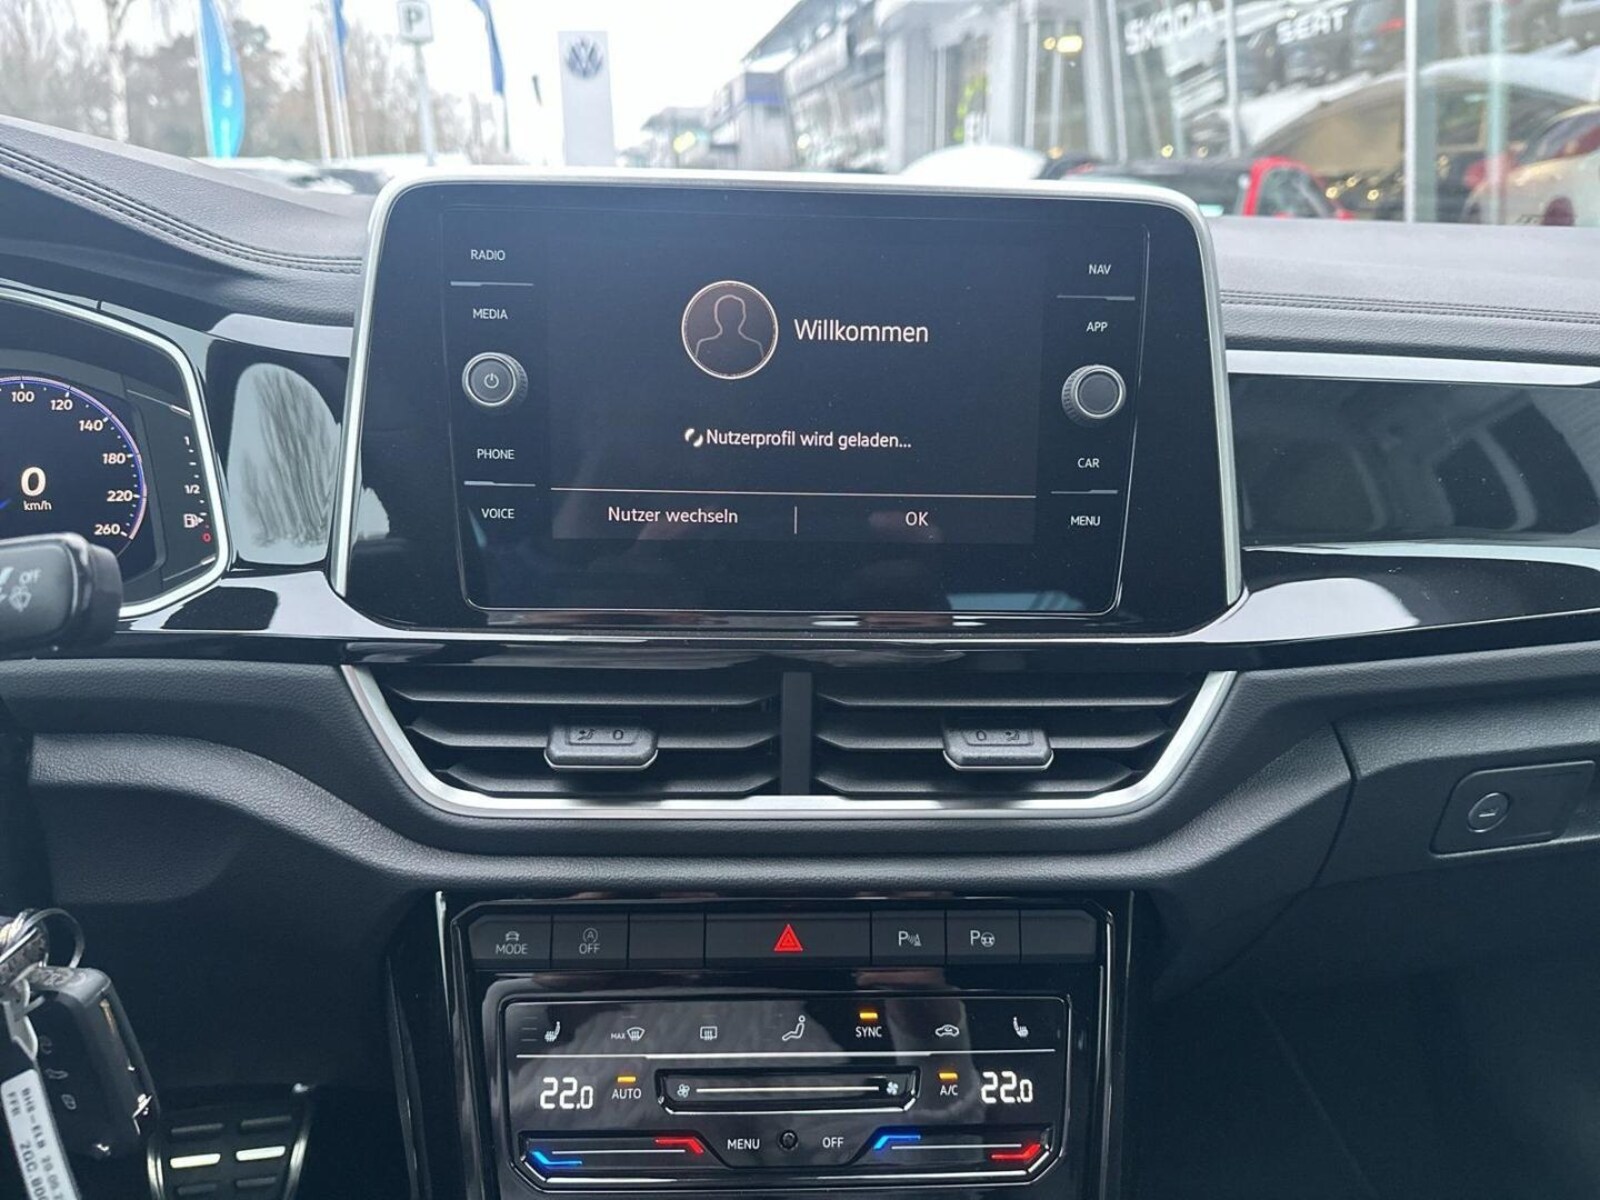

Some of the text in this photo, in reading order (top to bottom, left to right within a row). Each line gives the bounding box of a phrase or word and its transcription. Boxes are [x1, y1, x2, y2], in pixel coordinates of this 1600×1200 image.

[405, 5, 423, 33] P
[1276, 7, 1349, 45] SEAT
[470, 249, 506, 261] RADIO
[1088, 264, 1111, 275] NAV
[473, 308, 508, 320] MEDIA
[794, 319, 929, 343] Willkommen
[1086, 321, 1108, 332] APP
[11, 391, 35, 402] 100
[50, 399, 73, 411] 120
[79, 419, 103, 432] 140
[184, 435, 190, 446] 1
[706, 428, 912, 451] Nutzerprofil wird geladen...
[102, 453, 126, 464] 180
[477, 449, 515, 460] PHONE
[1078, 458, 1100, 469] CAR
[20, 466, 46, 496] 0
[184, 484, 201, 494] 1/2
[106, 490, 133, 502] 220
[23, 500, 52, 511] km/h
[481, 508, 515, 519] VOICE
[608, 506, 739, 525] Nutzer wechseln
[905, 511, 929, 527] OK
[1071, 515, 1101, 526] MENU
[94, 524, 121, 535] 260
[202, 532, 212, 543] 0
[495, 943, 528, 955] MODE
[579, 943, 601, 955] OFF
[610, 1032, 626, 1040] MAX
[855, 1026, 882, 1038] SYNC
[540, 1077, 594, 1109] 22.0
[940, 1085, 959, 1096] A/C
[981, 1071, 1034, 1103] 22.0
[612, 1088, 642, 1100] AUTO
[727, 1139, 760, 1150] MENU
[822, 1137, 844, 1148] OFF
